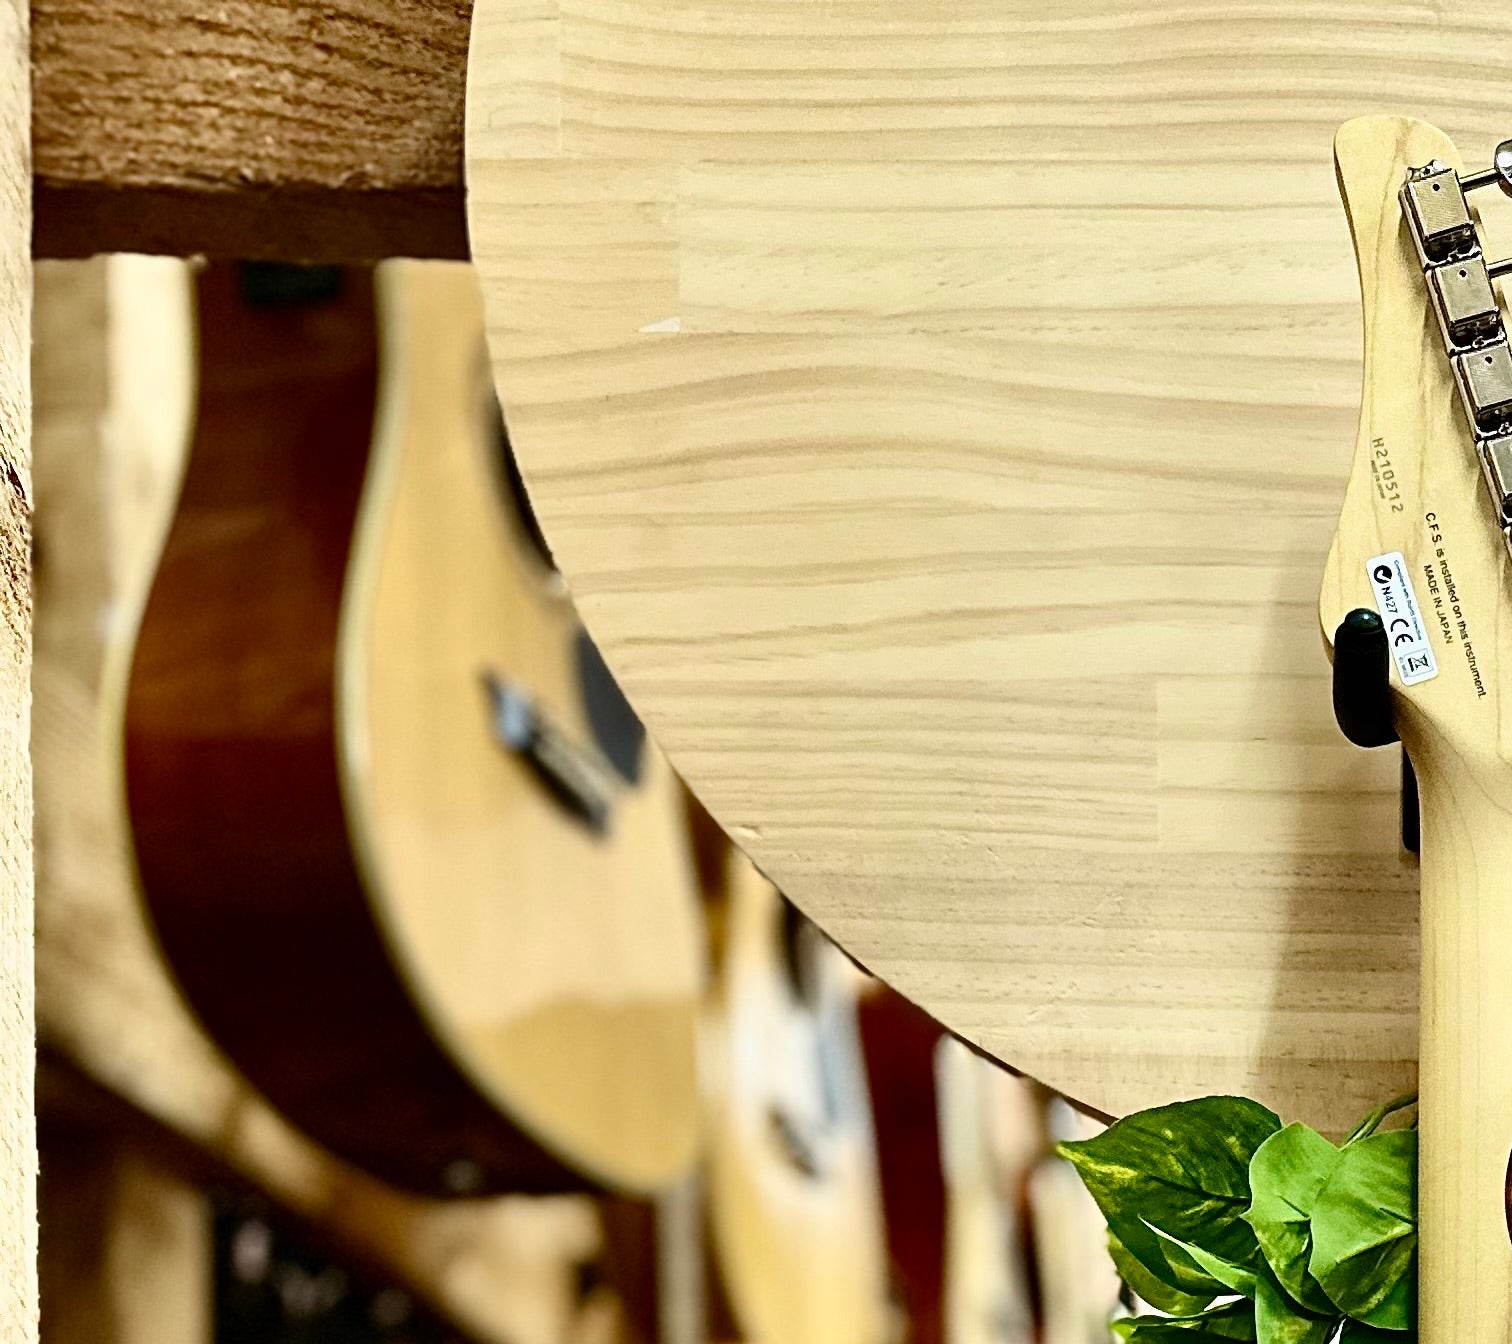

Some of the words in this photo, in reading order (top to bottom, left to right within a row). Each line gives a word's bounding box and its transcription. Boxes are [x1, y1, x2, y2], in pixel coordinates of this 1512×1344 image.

[1372, 437, 1404, 513] H210512
[1436, 548, 1445, 558] is
[1424, 564, 1440, 595] MADE
[1440, 559, 1460, 603] installed
[1381, 586, 1399, 614] N427
[1433, 596, 1443, 608] IN
[1452, 605, 1462, 619] on
[1436, 610, 1453, 644] JAPAN
[1457, 620, 1468, 641] this
